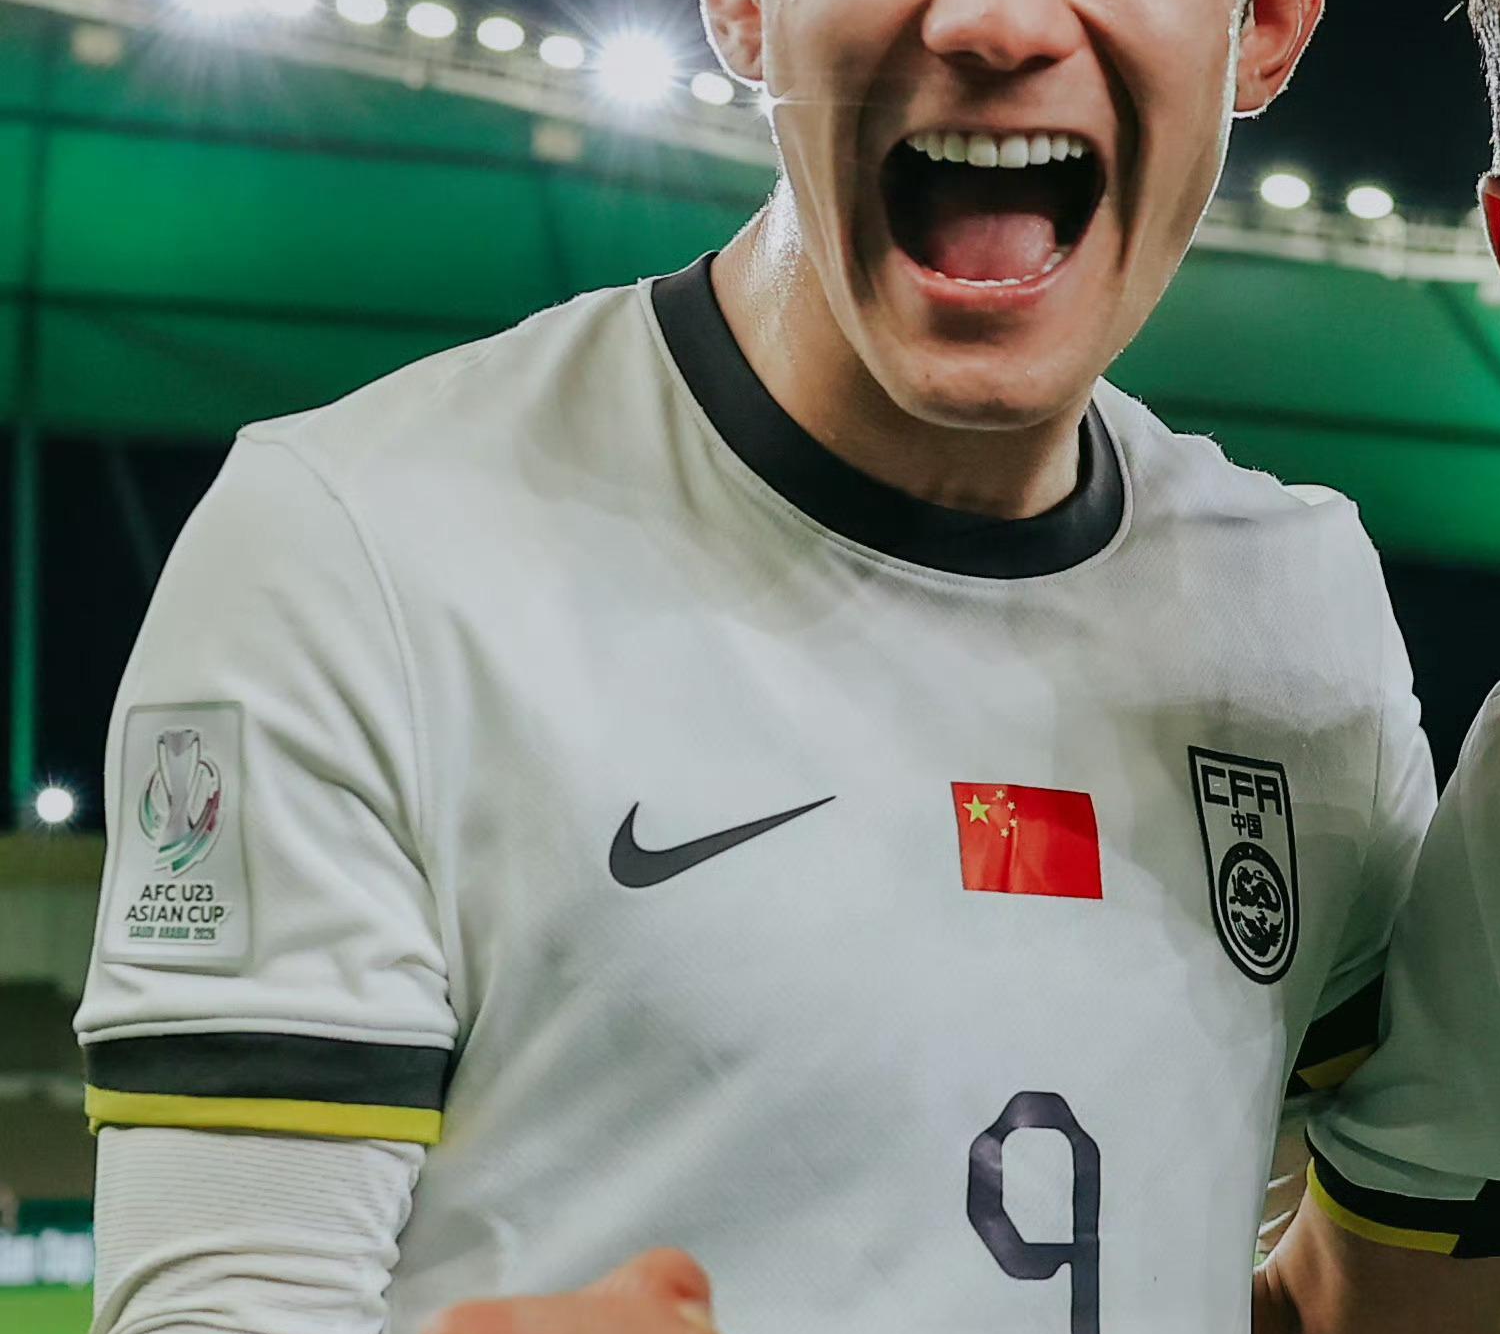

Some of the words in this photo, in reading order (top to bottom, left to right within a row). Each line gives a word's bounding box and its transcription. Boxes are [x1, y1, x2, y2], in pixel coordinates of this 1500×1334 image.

[1201, 764, 1282, 816] CFA
[1230, 809, 1263, 840] 中国
[140, 884, 176, 902] AFC
[181, 884, 214, 903] U23
[124, 904, 184, 923] ASIAN
[187, 905, 225, 924] CUP
